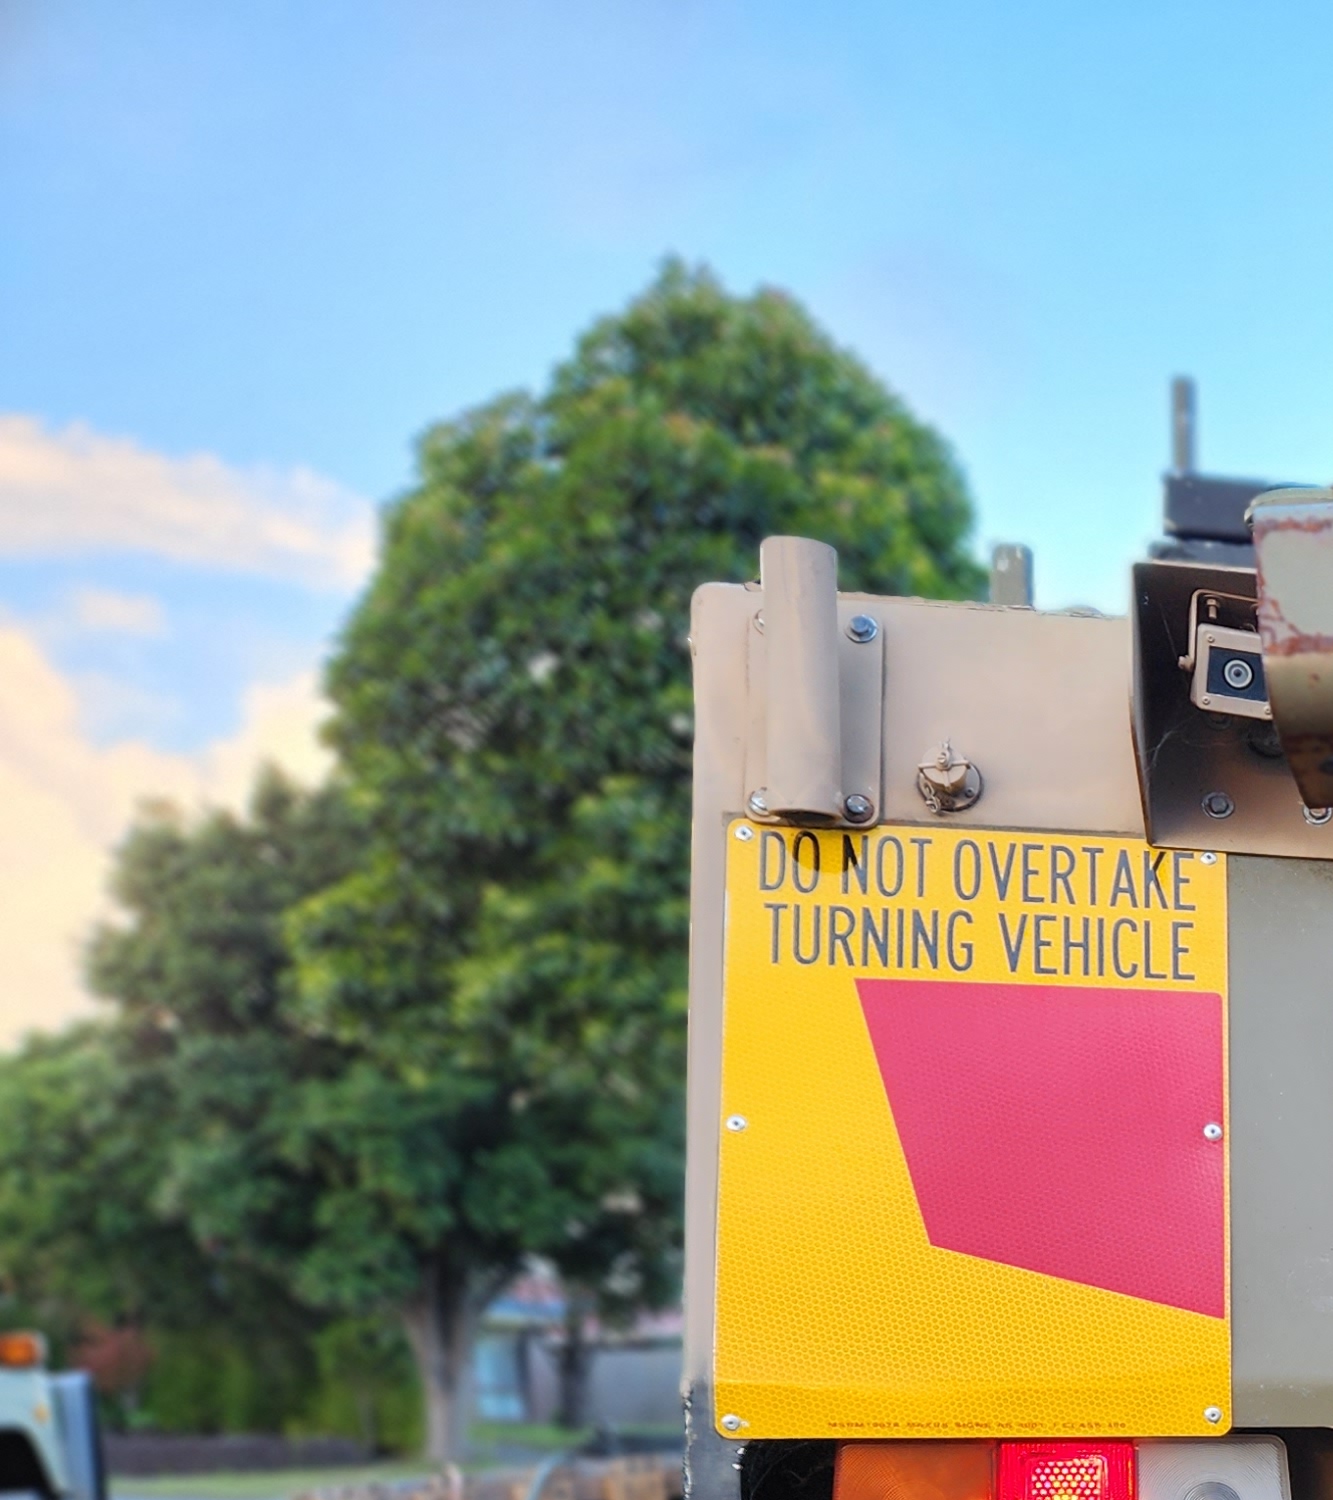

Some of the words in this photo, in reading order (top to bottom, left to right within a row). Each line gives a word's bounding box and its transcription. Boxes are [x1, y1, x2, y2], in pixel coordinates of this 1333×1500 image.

[759, 830, 820, 893] DO
[841, 834, 932, 897] NOT
[954, 839, 1196, 911] OVERTAKE
[763, 902, 973, 972] TURNING
[998, 912, 1195, 981] VEHICLE
